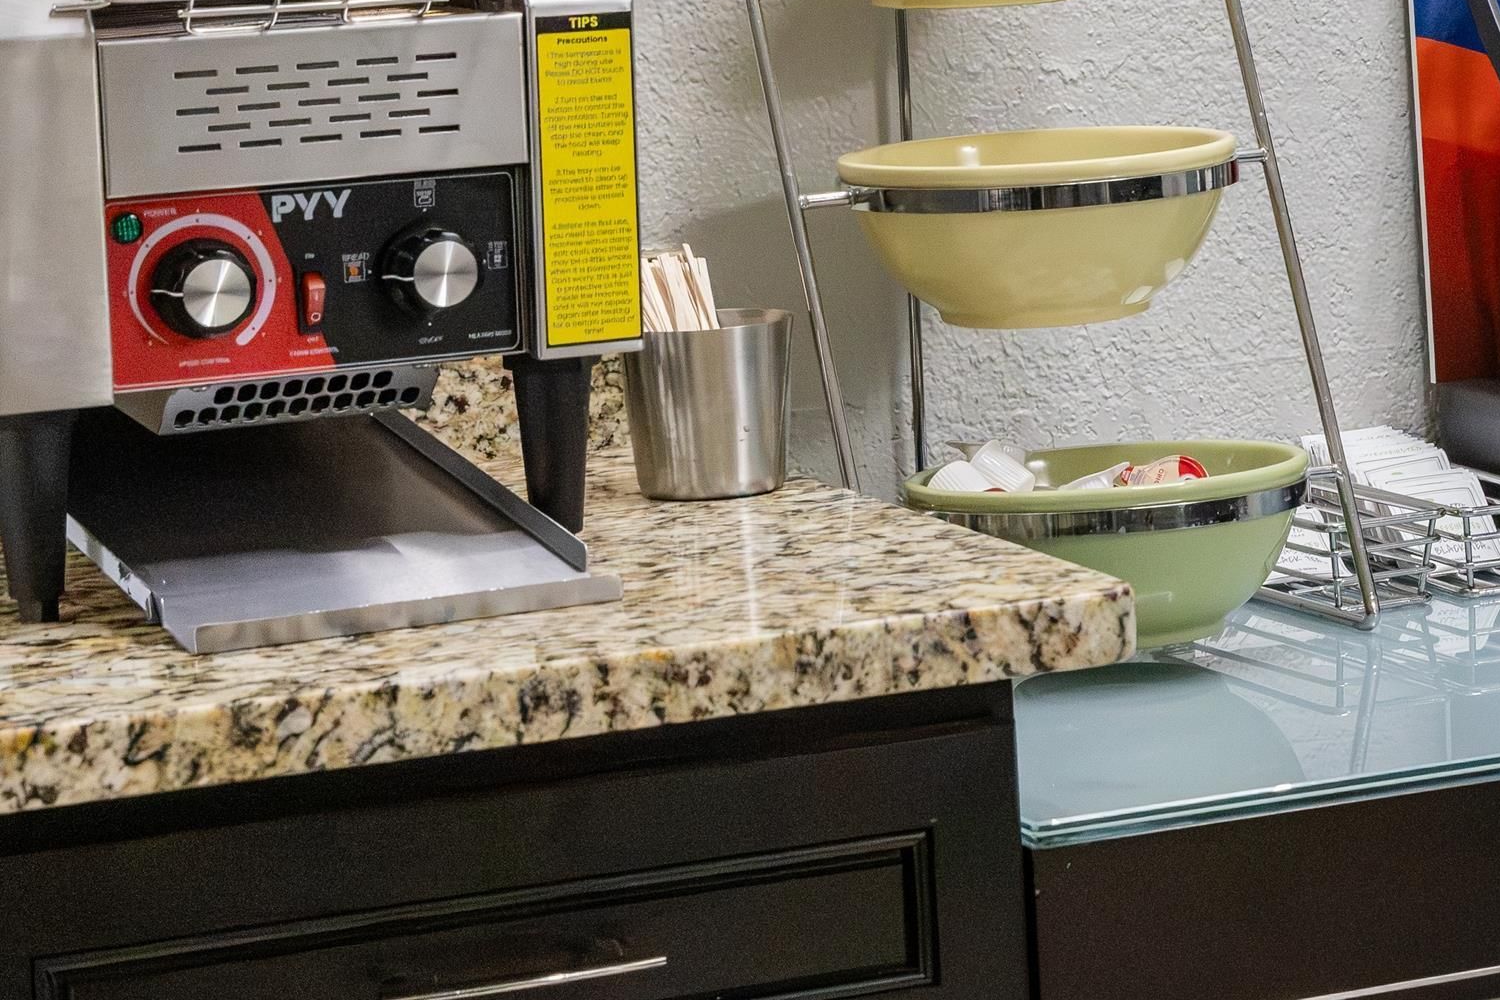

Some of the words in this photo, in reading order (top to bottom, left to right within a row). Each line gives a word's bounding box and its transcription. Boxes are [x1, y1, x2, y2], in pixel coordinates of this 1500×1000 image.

[568, 16, 598, 28] TIPS
[557, 36, 608, 45] Precautions
[271, 188, 352, 223] PYY
